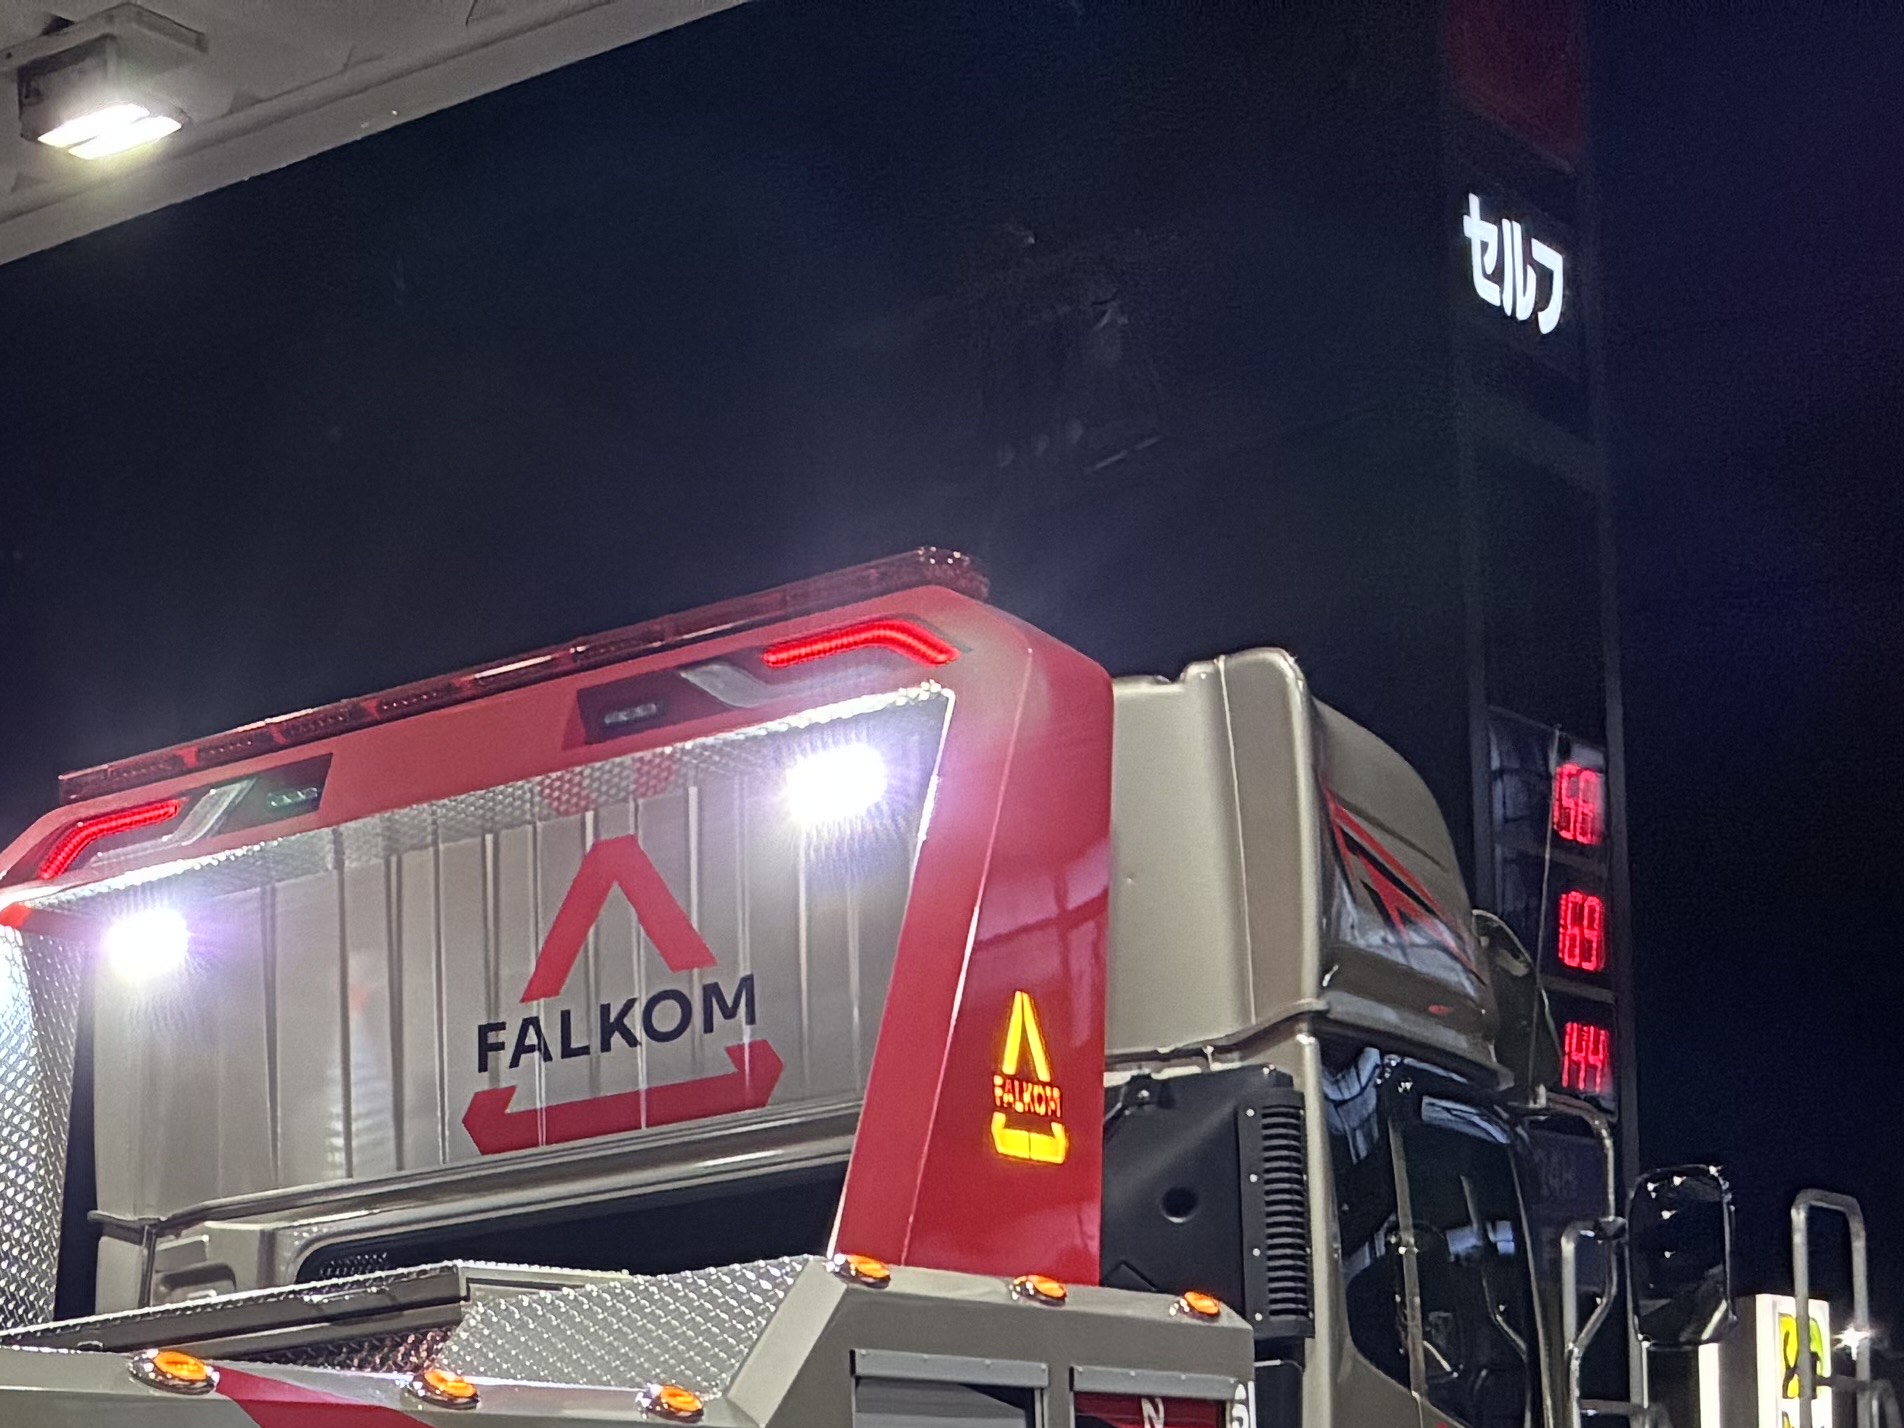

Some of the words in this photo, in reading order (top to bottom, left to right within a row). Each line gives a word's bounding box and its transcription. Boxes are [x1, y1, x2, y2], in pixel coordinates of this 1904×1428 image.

[1463, 193, 1564, 335] セルフ
[478, 973, 756, 1074] FALKOM
[993, 1074, 1062, 1118] FALKOM
